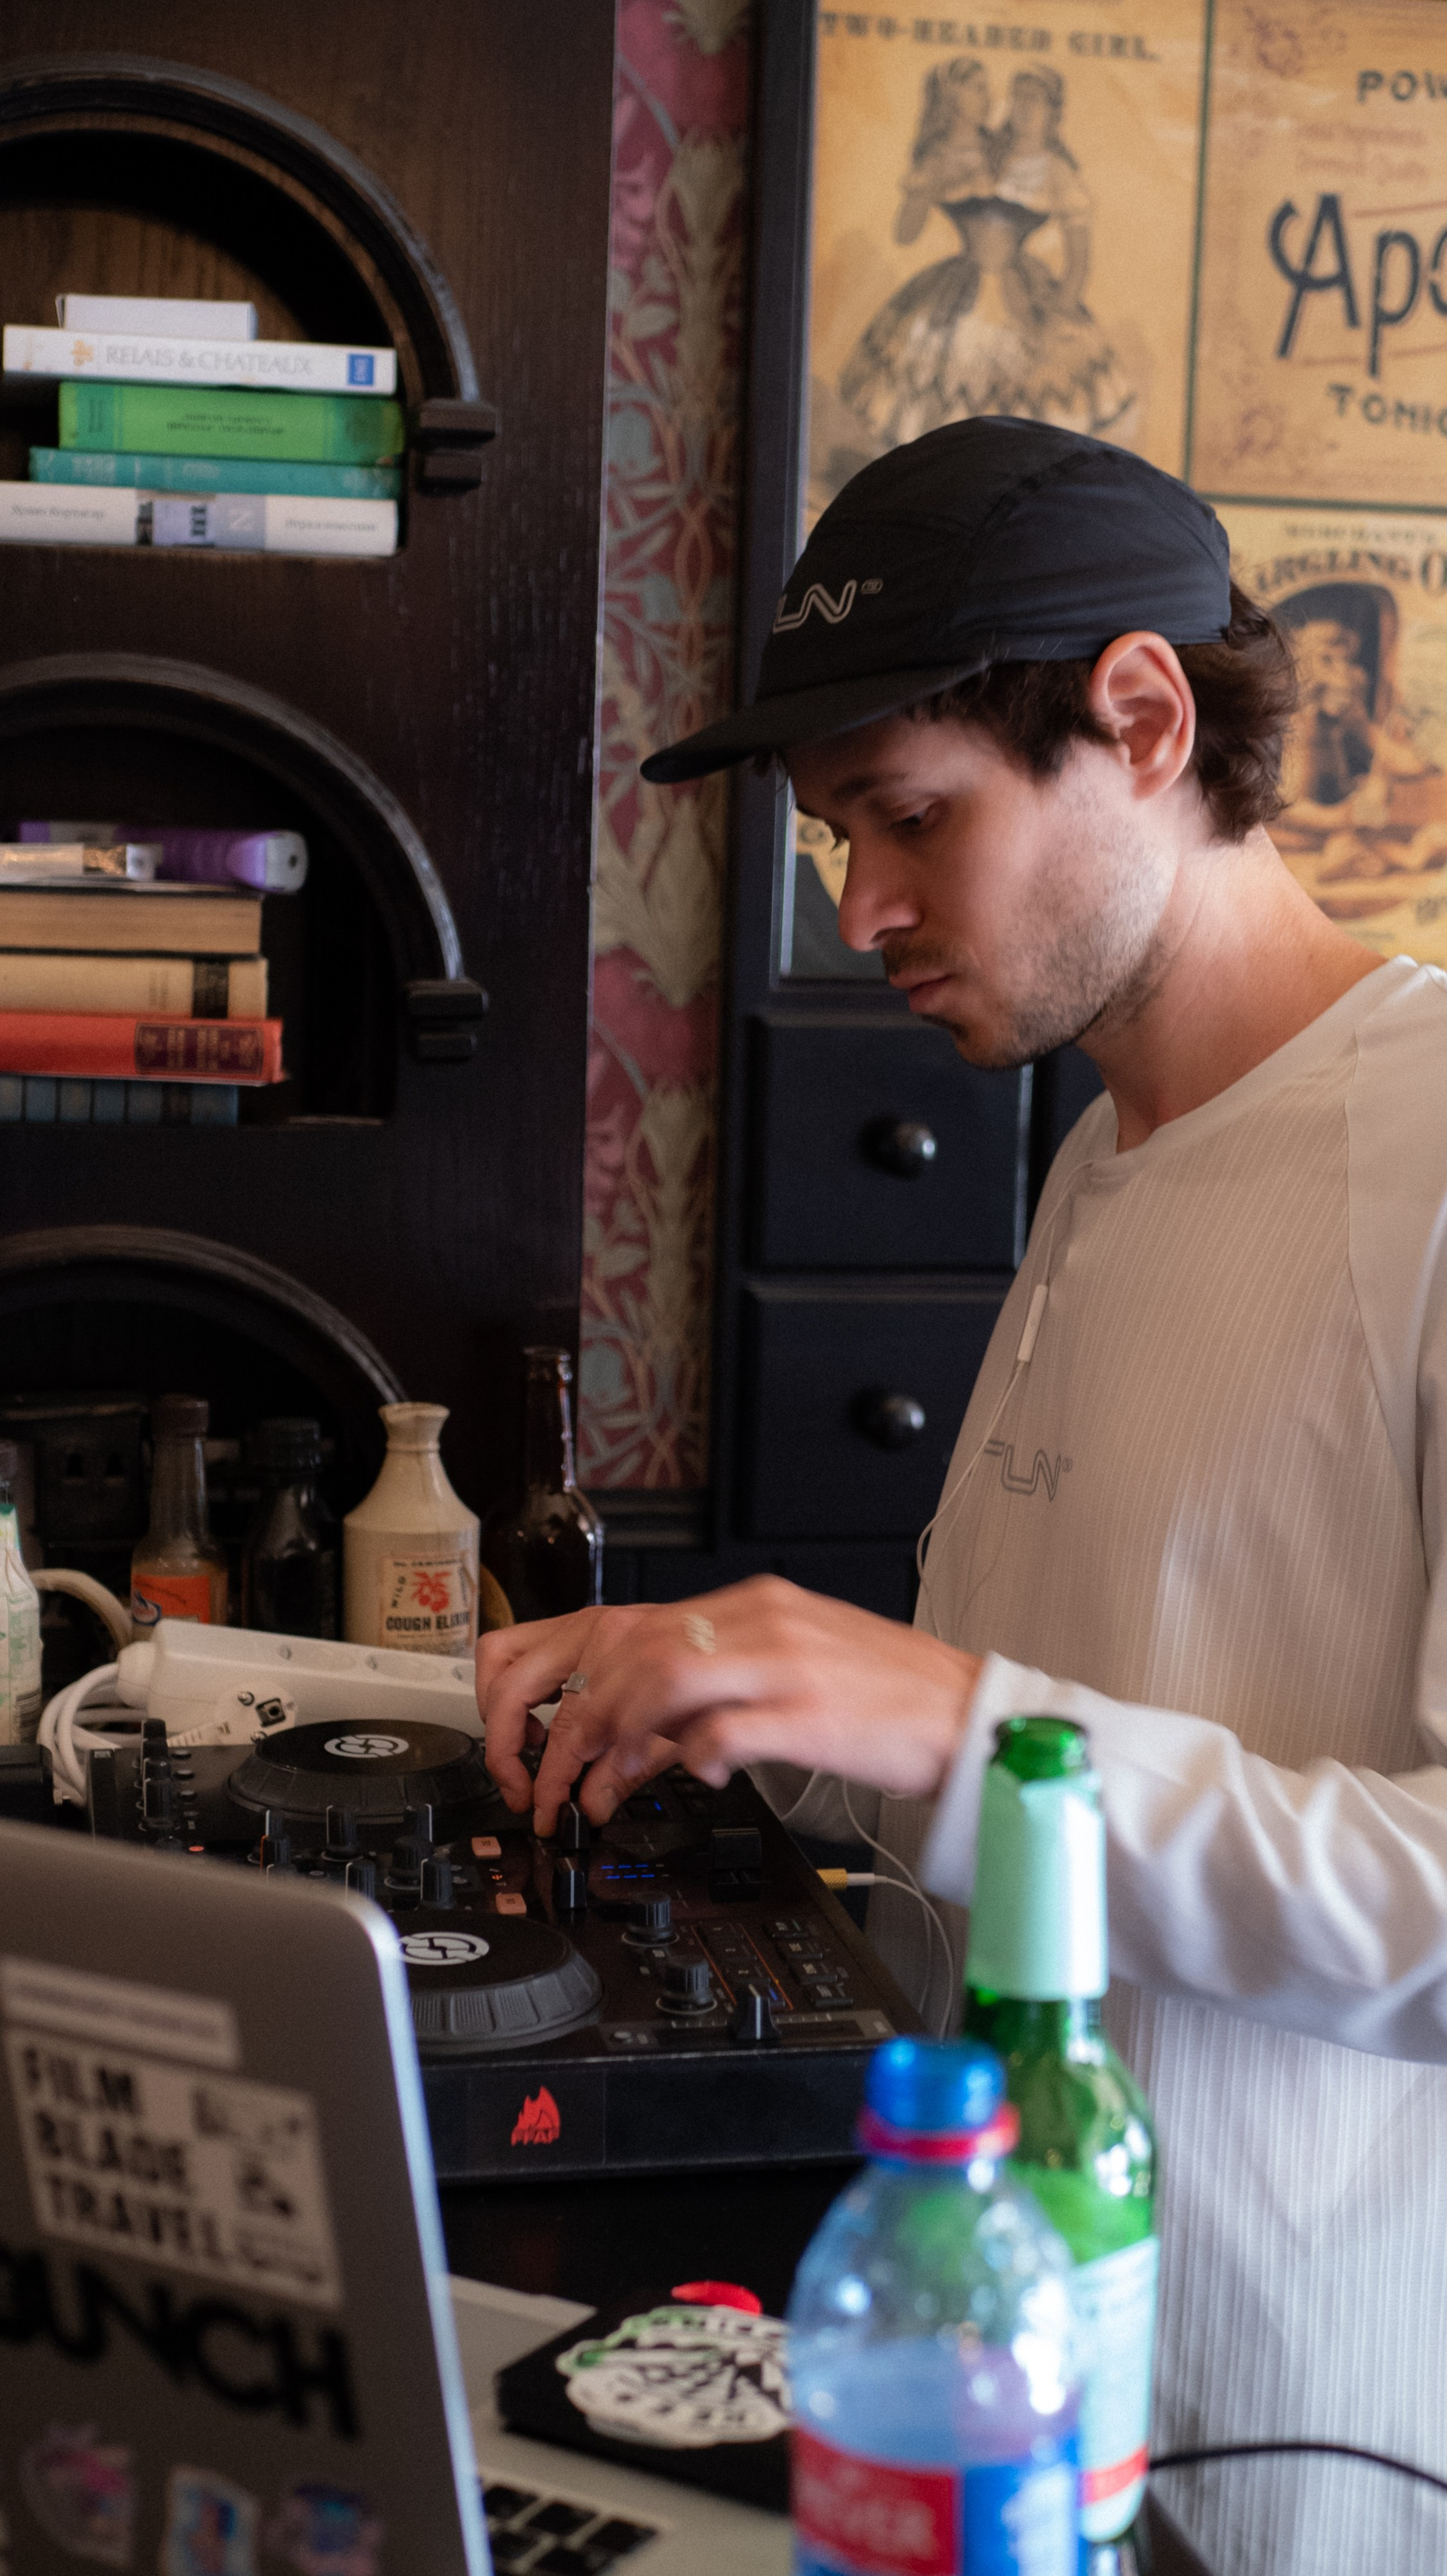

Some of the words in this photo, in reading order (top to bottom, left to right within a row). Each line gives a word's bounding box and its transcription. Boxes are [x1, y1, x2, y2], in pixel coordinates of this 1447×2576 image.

[177, 351, 194, 369] &
[386, 1615, 432, 1631] COUGH
[23, 2047, 137, 2114] FILM
[49, 2174, 226, 2262] TRAVEL
